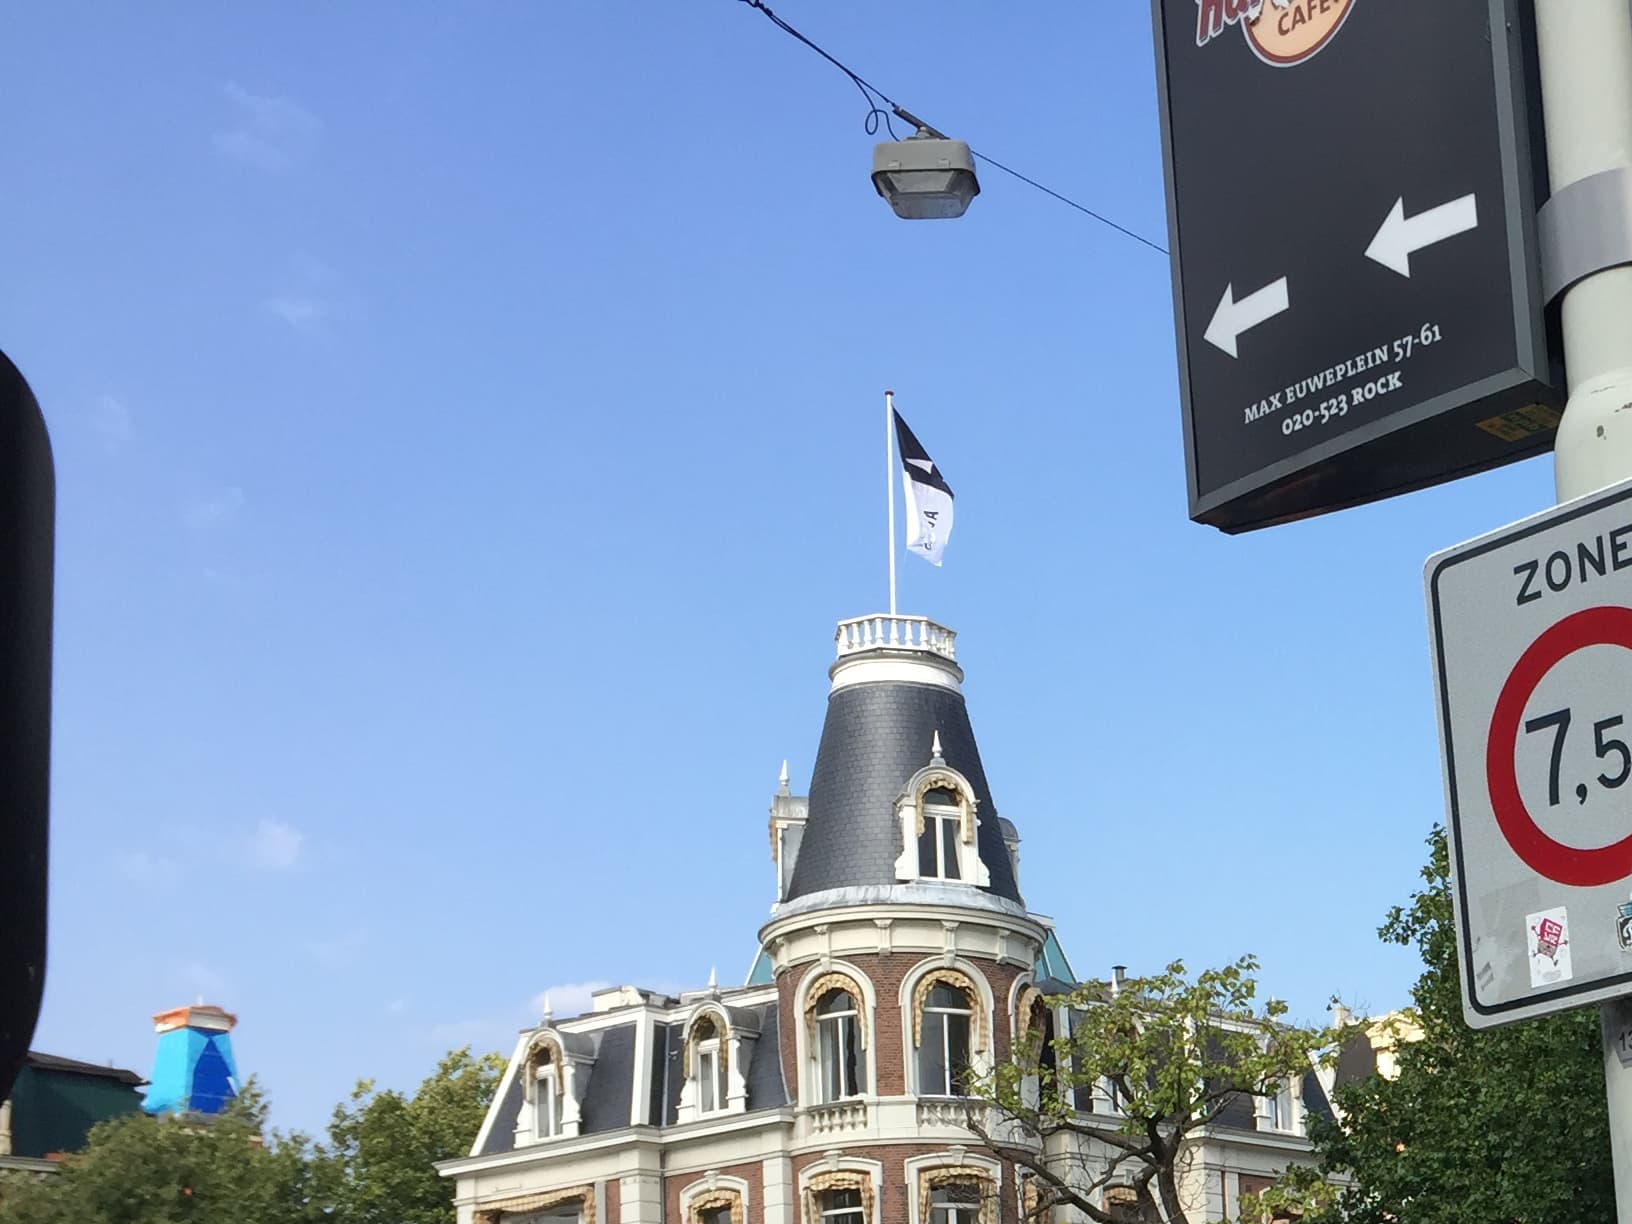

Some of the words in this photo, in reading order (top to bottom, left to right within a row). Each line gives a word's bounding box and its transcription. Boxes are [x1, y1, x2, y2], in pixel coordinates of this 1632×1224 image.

[1244, 393, 1282, 424] MAX
[1285, 345, 1389, 404] EUWEPLEIN
[1393, 322, 1442, 362] 57-61
[1282, 394, 1348, 435] 020-523
[1351, 371, 1403, 405] ROCK
